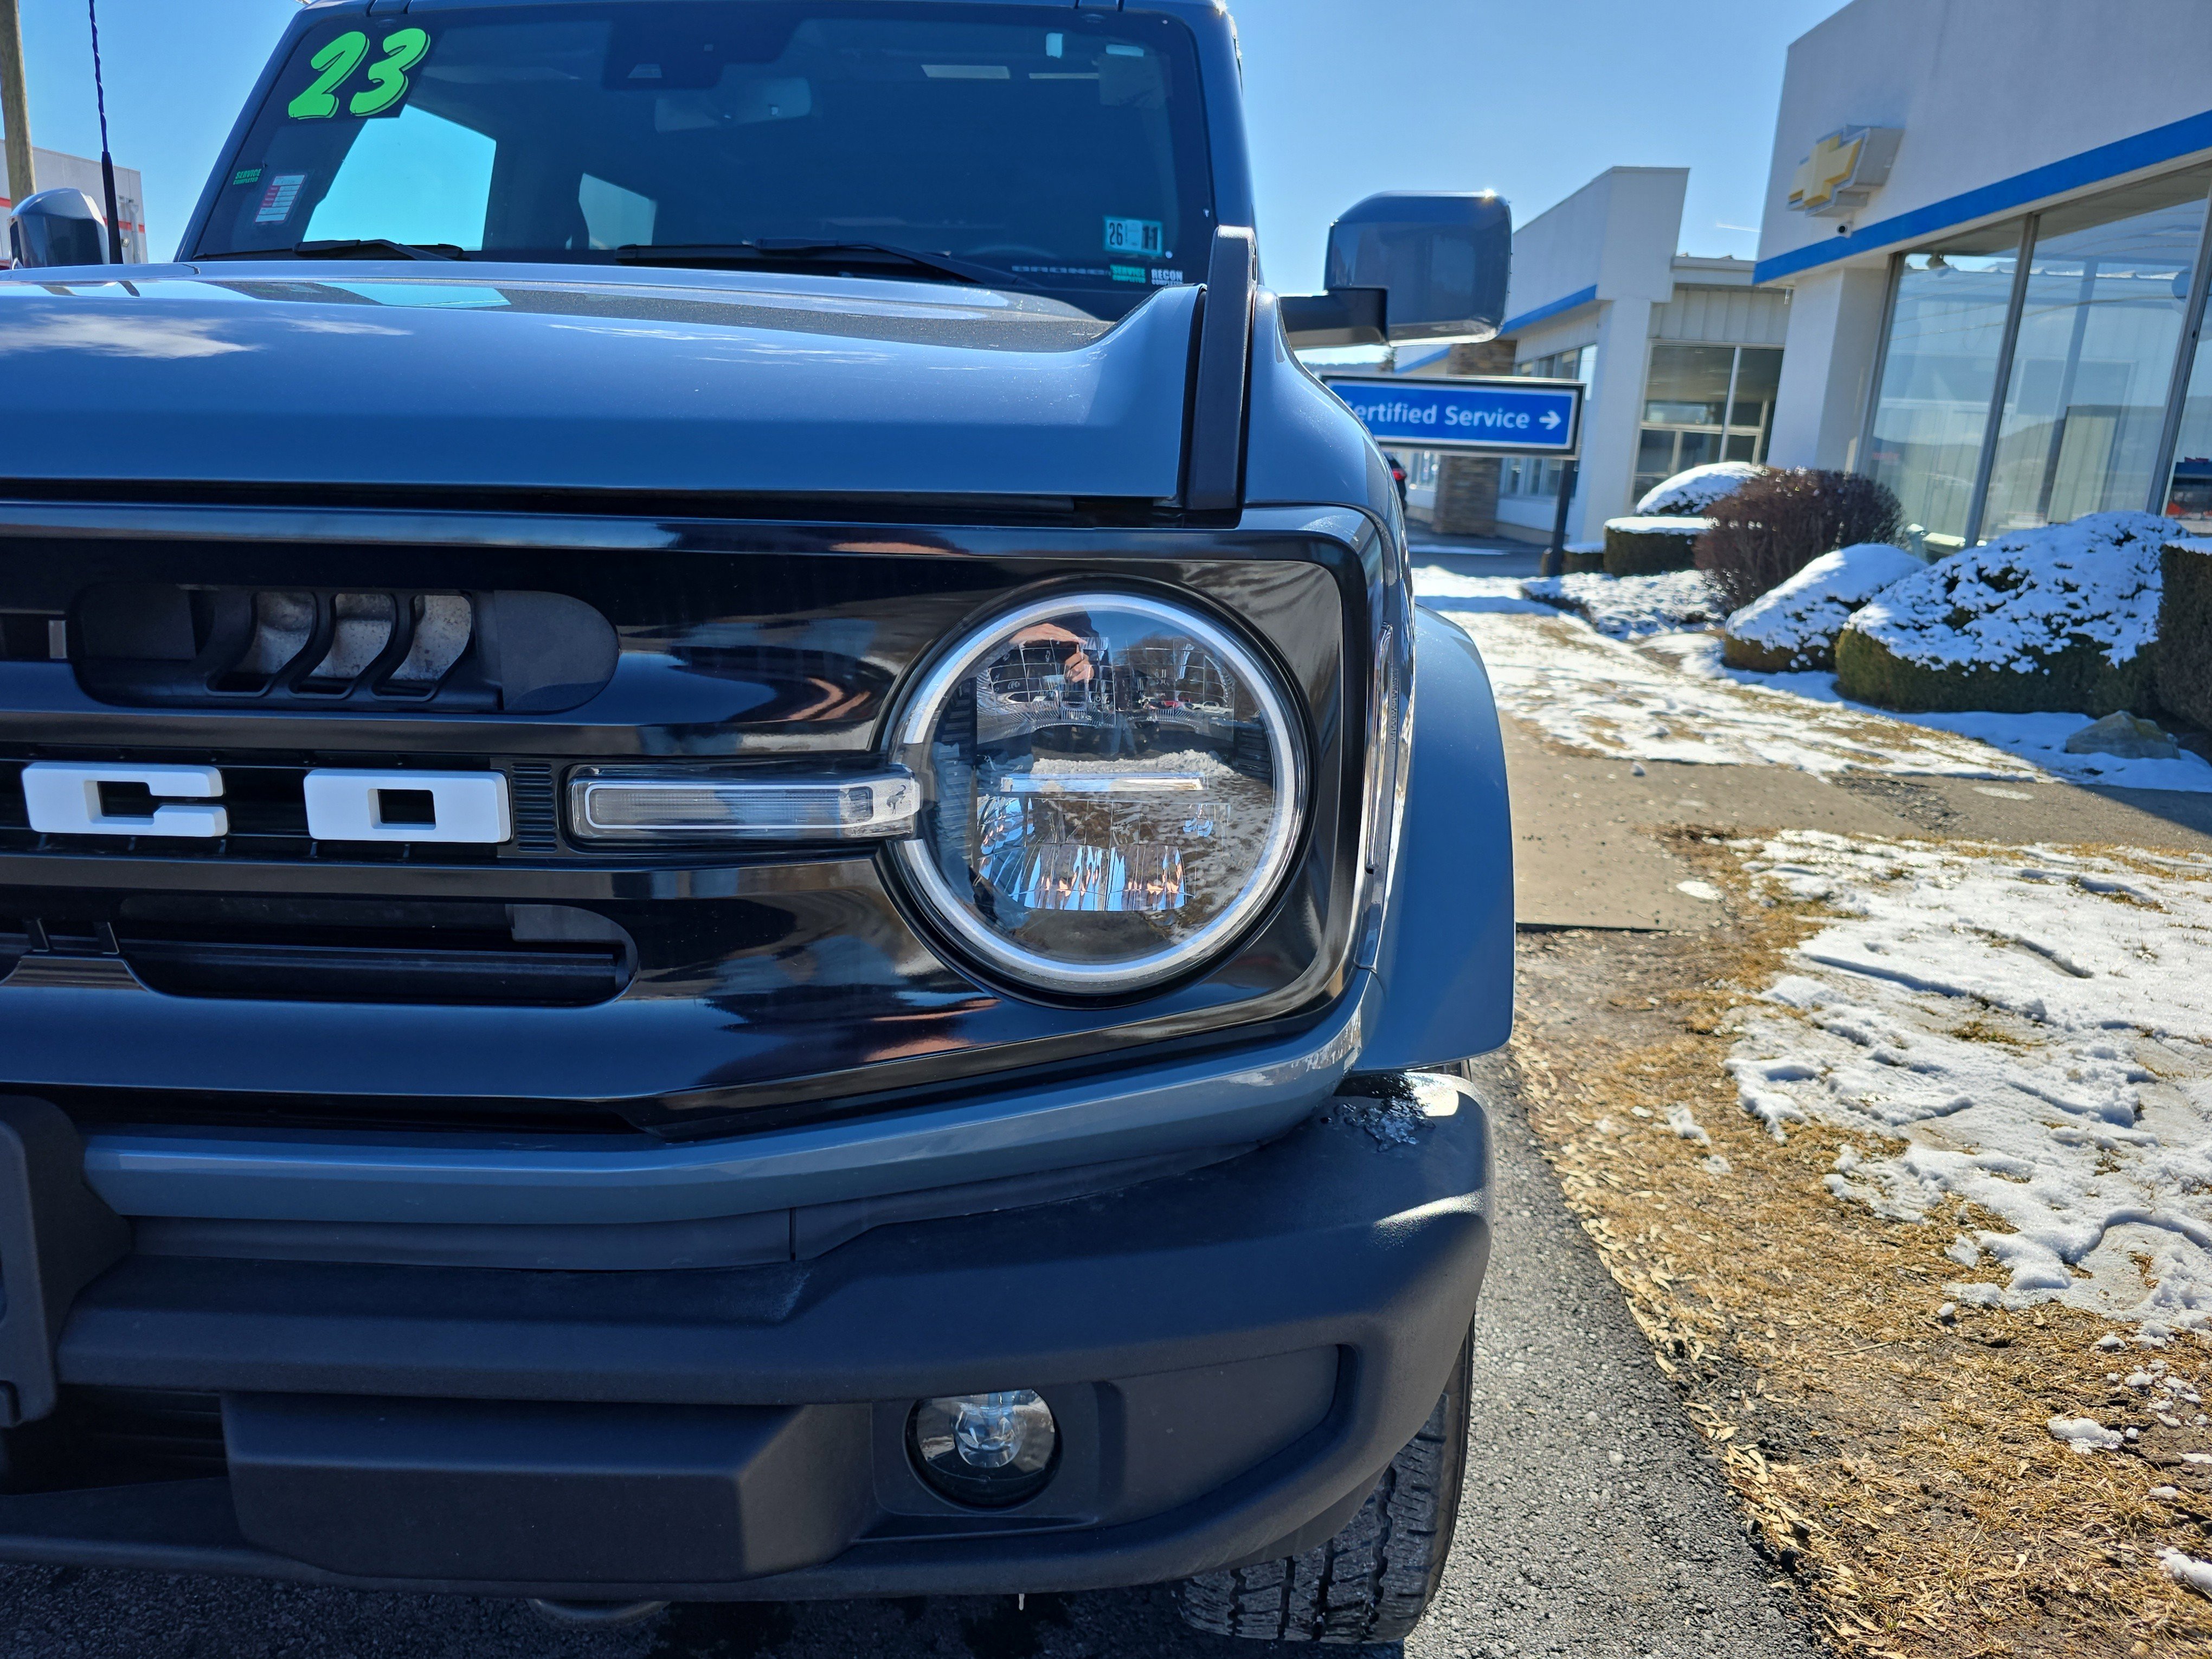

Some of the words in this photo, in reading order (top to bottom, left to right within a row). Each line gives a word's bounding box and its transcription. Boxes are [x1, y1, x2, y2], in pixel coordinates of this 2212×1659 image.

[288, 28, 431, 119] 23
[235, 168, 262, 179] SERVICE
[1109, 222, 1123, 246] 26
[1142, 226, 1159, 252] 11
[1151, 268, 1183, 281] RECON
[1346, 400, 1437, 425] ertified
[1444, 405, 1531, 429] Service
